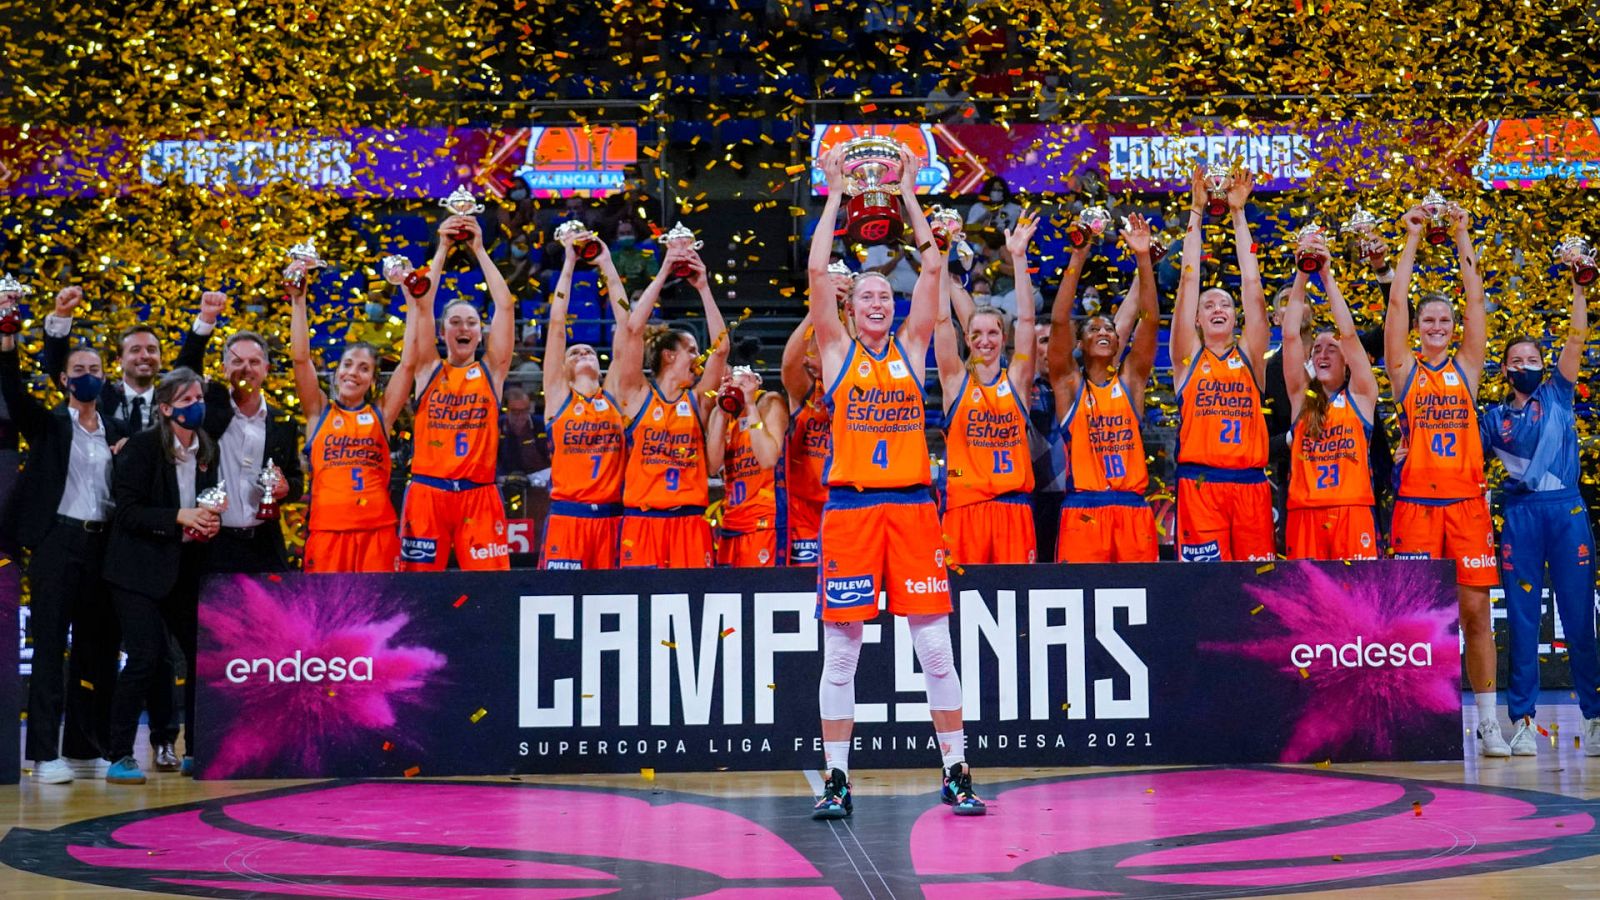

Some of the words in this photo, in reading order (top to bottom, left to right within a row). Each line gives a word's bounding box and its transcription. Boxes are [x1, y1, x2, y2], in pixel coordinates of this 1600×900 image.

[849, 386, 905, 403] Cultura
[428, 404, 488, 421] Esfuerzo
[847, 404, 921, 422] Esfuerzo
[1416, 406, 1469, 420] fuerzo
[564, 419, 610, 431] Cultura
[1220, 419, 1242, 444] 21
[455, 433, 469, 457] 6
[563, 432, 621, 446] Esfuerzo
[1431, 433, 1456, 457] 42
[323, 446, 383, 463] Esfuerzo
[872, 440, 888, 469] 4
[993, 450, 1013, 474] 15
[1104, 454, 1126, 478] 18
[591, 455, 602, 479] 7
[1317, 463, 1339, 489] 23
[351, 467, 364, 491] 5
[666, 467, 680, 491] 9
[402, 538, 435, 550] PULEVA
[1183, 543, 1218, 555] PULEVA
[547, 561, 582, 570] PULEVA
[827, 579, 872, 590] PULEVA
[905, 577, 949, 593] teika
[1290, 635, 1432, 668] endesa
[226, 650, 373, 683] endesa
[519, 739, 686, 756] SUPERCOPA
[709, 738, 772, 753] LIGA
[794, 736, 937, 752] FEENINA
[1088, 733, 1153, 748] 2021
